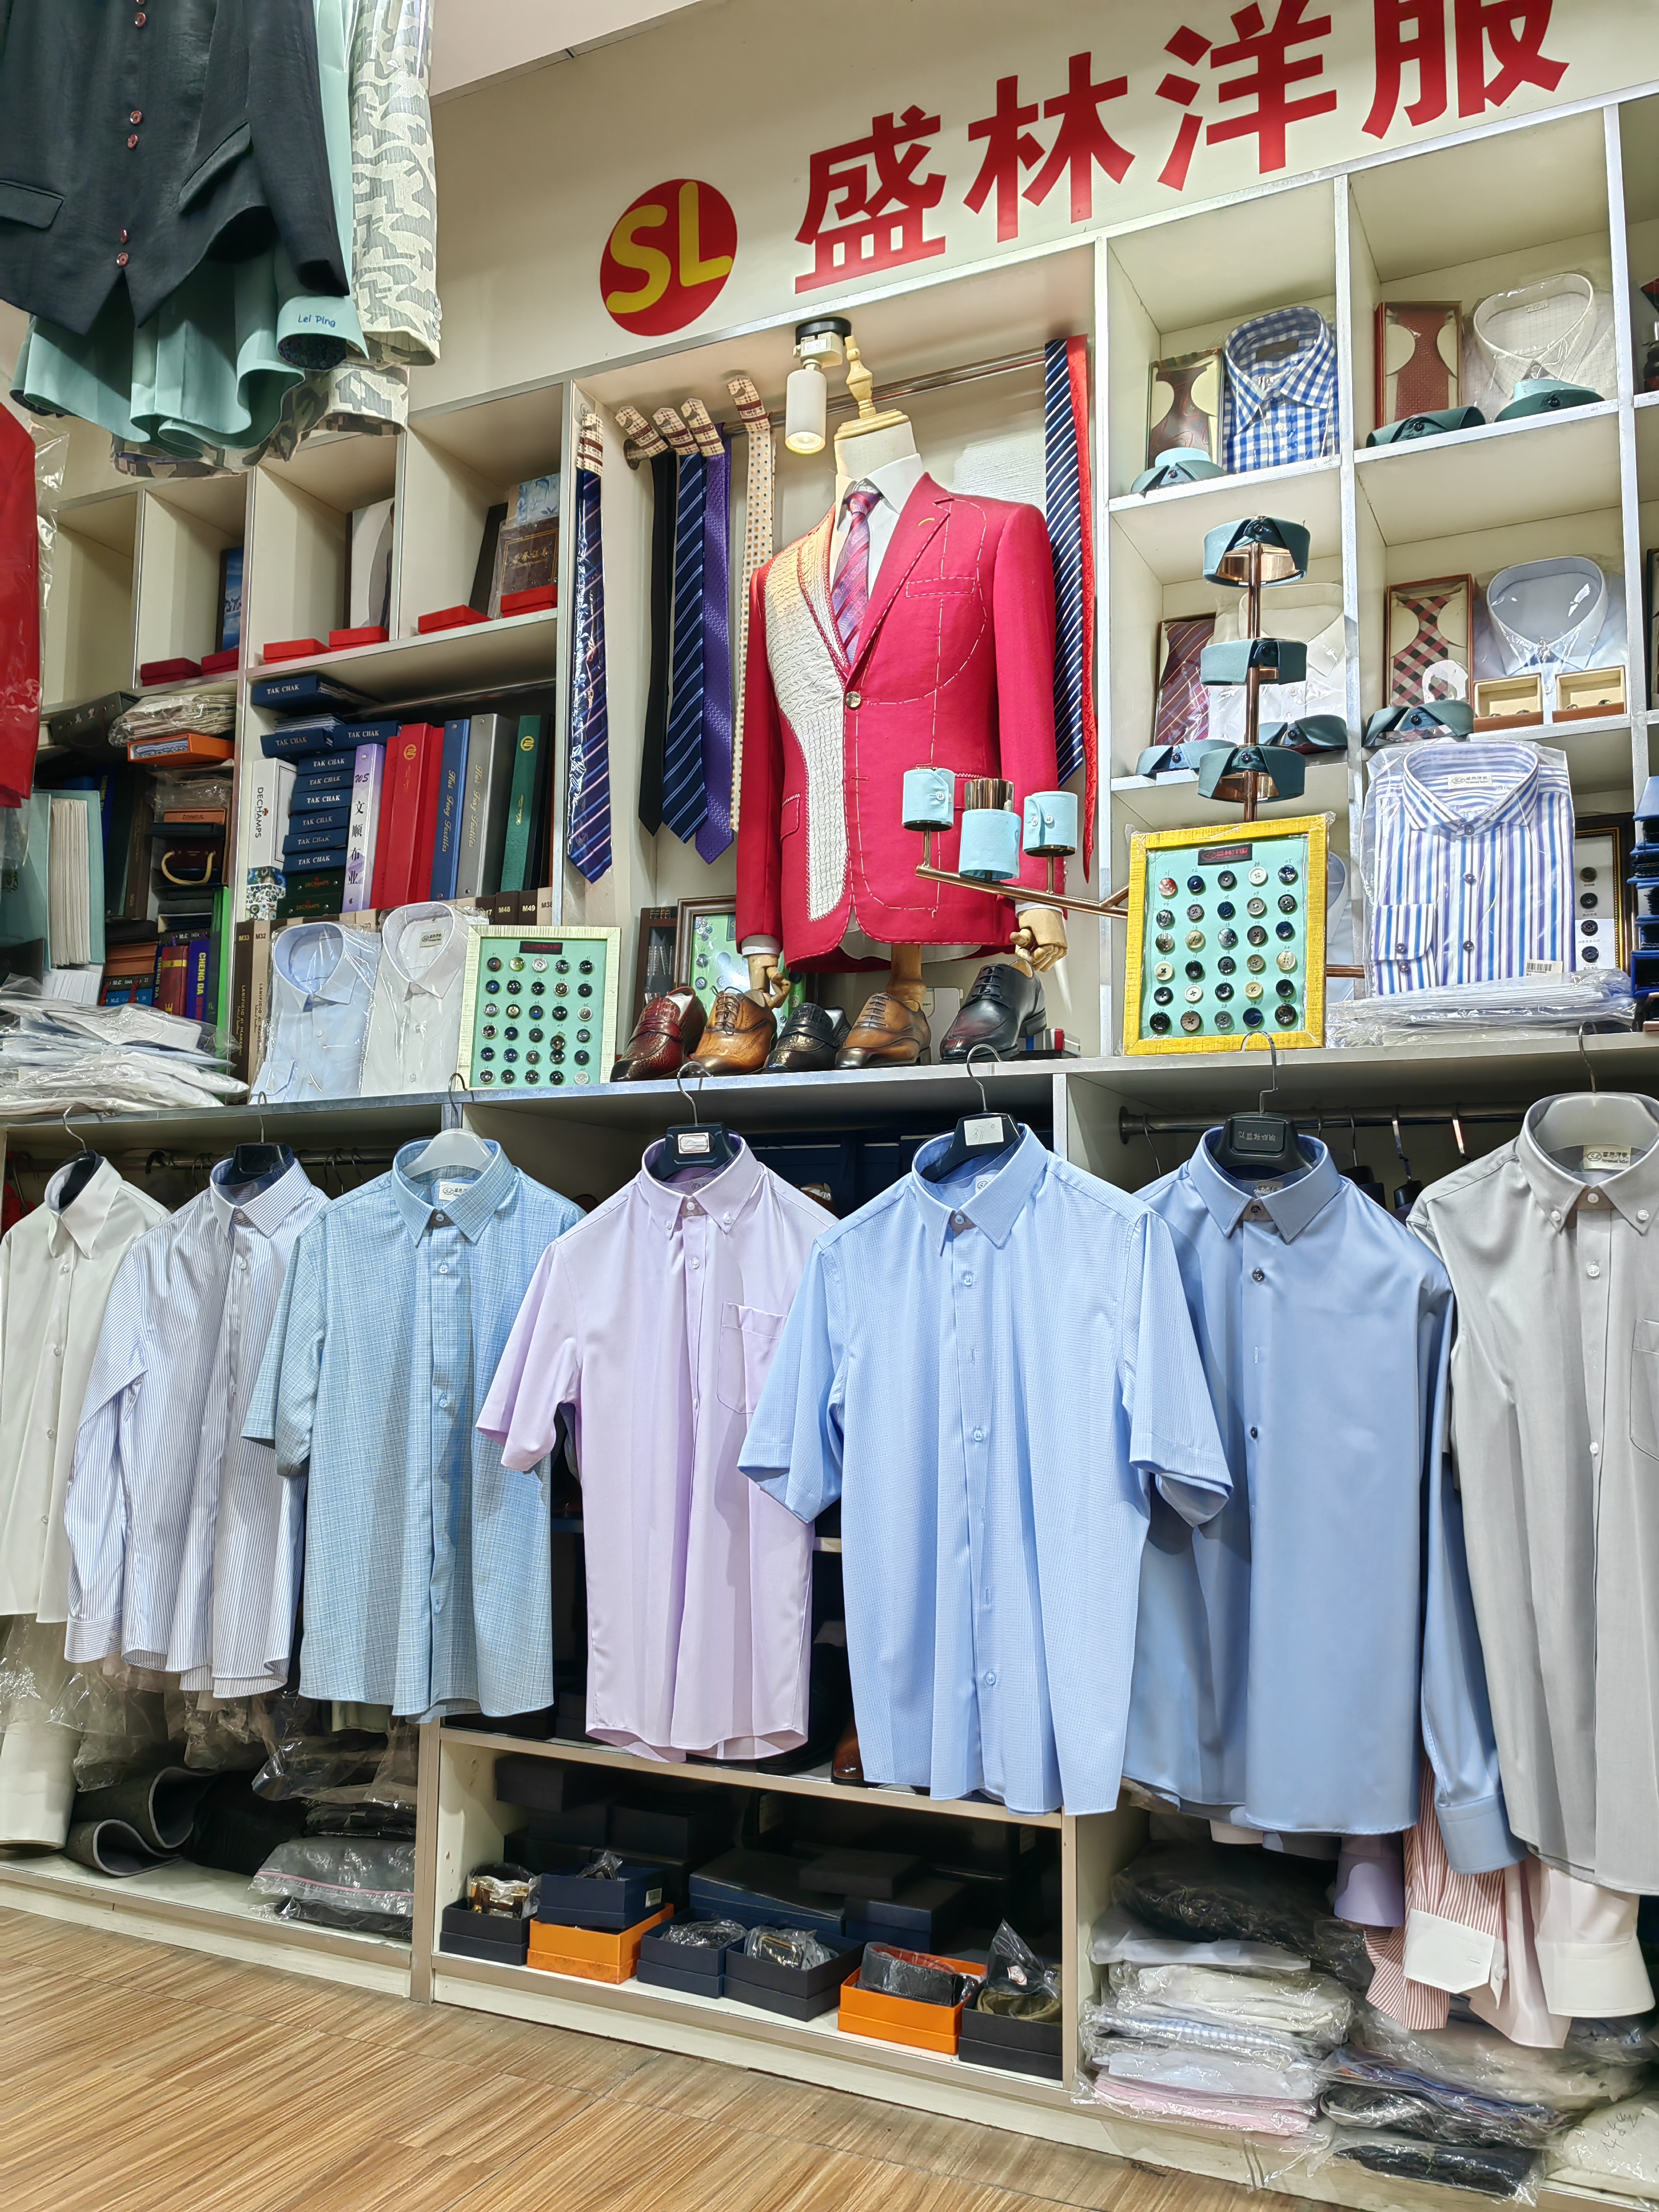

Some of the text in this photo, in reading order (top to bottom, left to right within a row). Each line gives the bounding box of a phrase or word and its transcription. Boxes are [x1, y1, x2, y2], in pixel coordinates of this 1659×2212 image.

[795, 0, 1569, 294] 盛林洋服
[605, 181, 734, 314] SL
[298, 314, 336, 328] Lei Ping
[281, 684, 299, 692] CHAK
[255, 787, 264, 839] DECHAMPS
[347, 800, 366, 885] 文顺布业
[198, 953, 206, 981] CHENG
